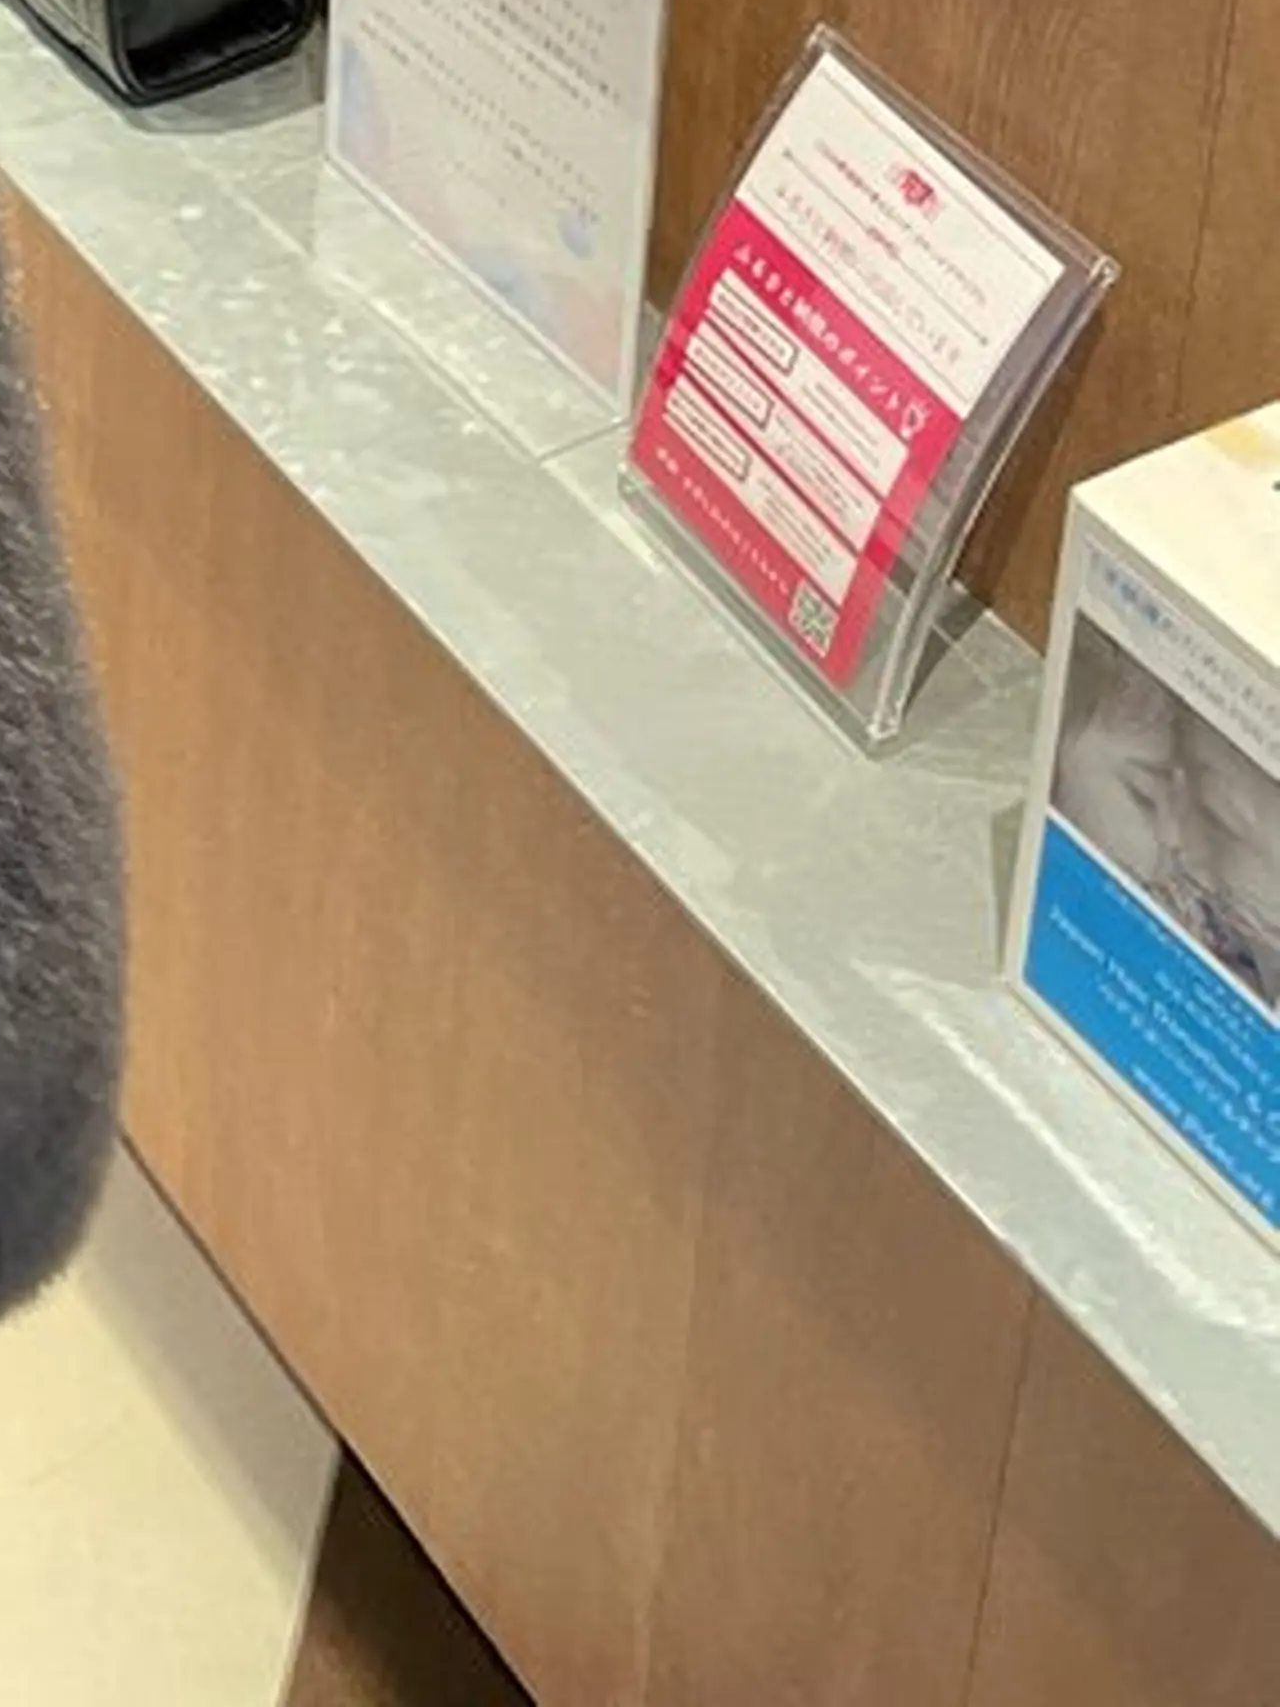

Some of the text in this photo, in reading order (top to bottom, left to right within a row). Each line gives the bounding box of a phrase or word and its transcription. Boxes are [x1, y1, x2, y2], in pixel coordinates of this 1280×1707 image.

[732, 239, 902, 411] ふるさと納税のポイント
